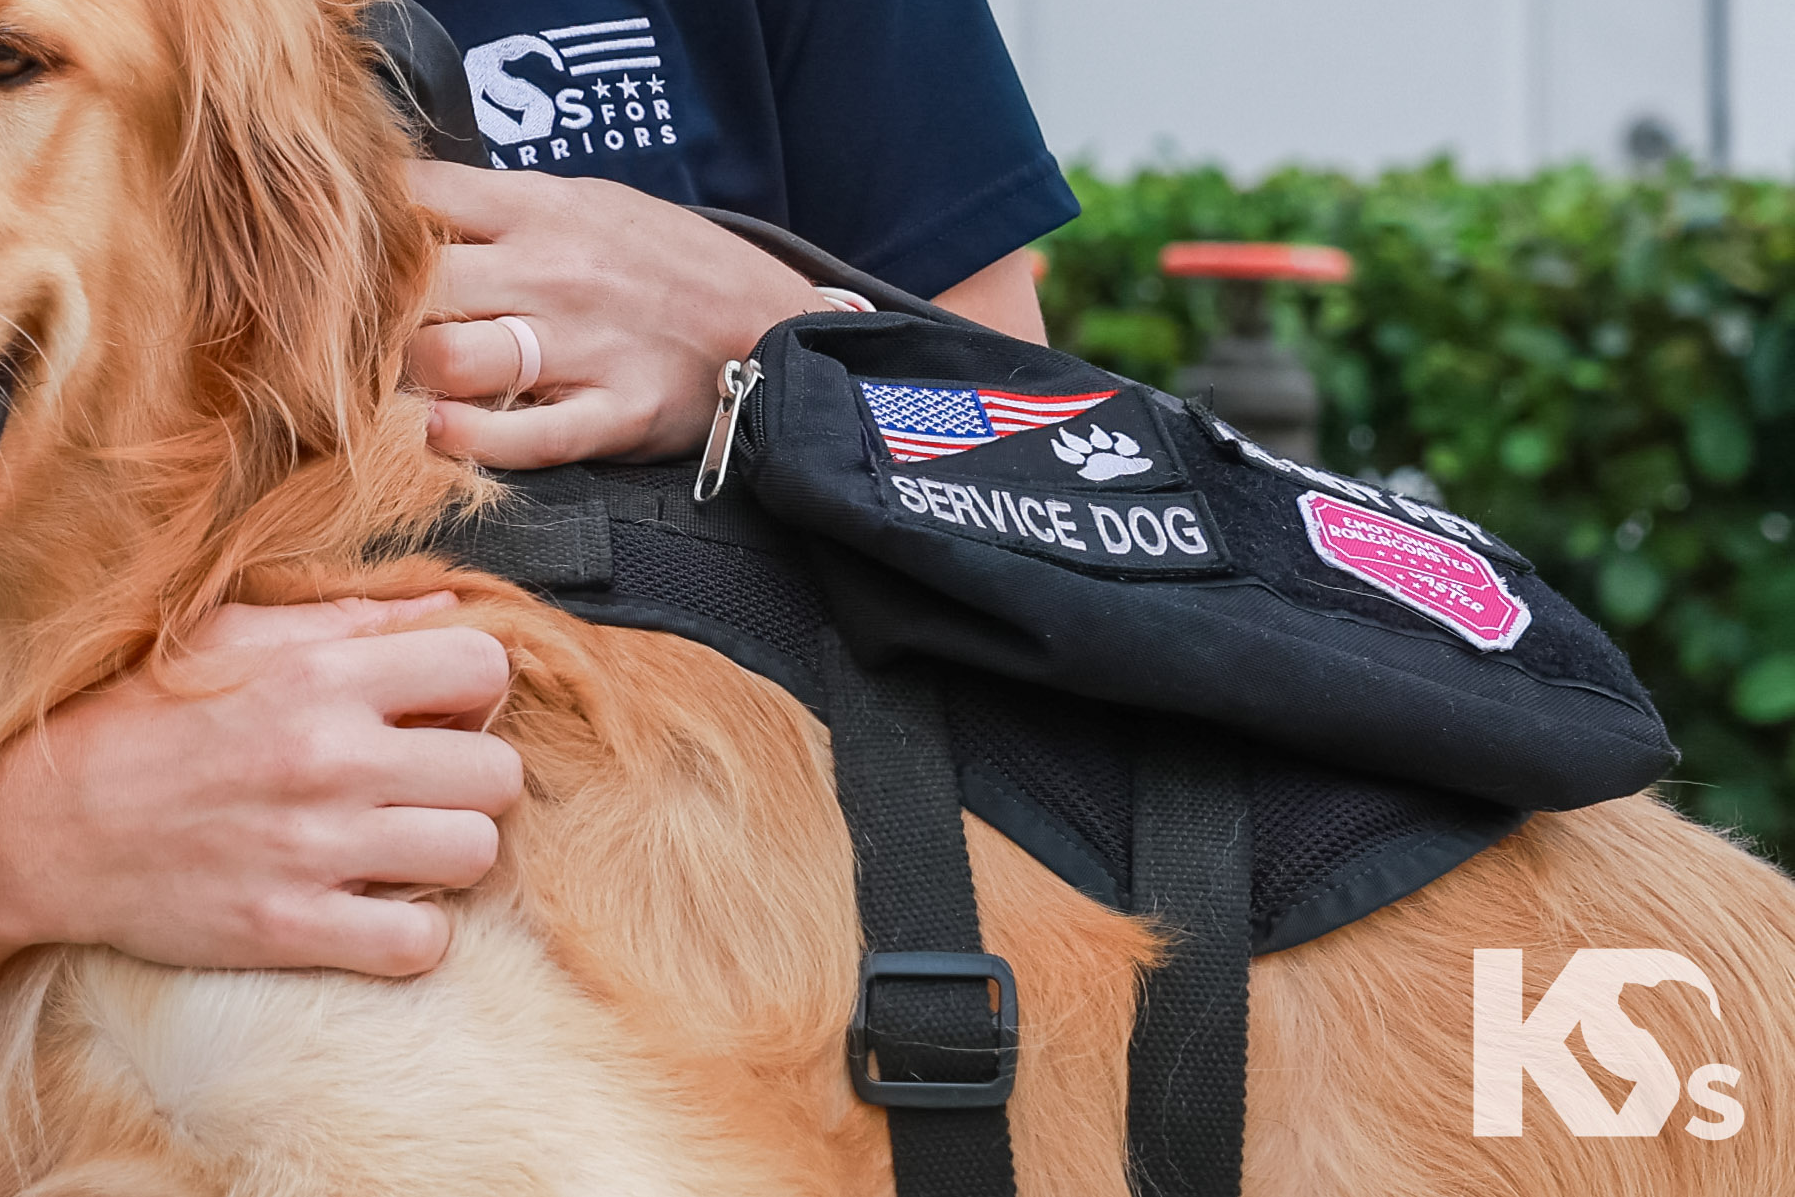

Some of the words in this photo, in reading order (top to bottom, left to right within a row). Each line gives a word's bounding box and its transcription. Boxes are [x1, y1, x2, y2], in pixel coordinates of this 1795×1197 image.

[601, 99, 672, 125] FOR
[489, 124, 678, 170] ARRIORS
[890, 474, 1087, 552] SERVICE
[1088, 502, 1208, 556] DOG
[1342, 516, 1450, 558] EMOTIONAL
[1327, 523, 1476, 575] ROLLERCOASTER
